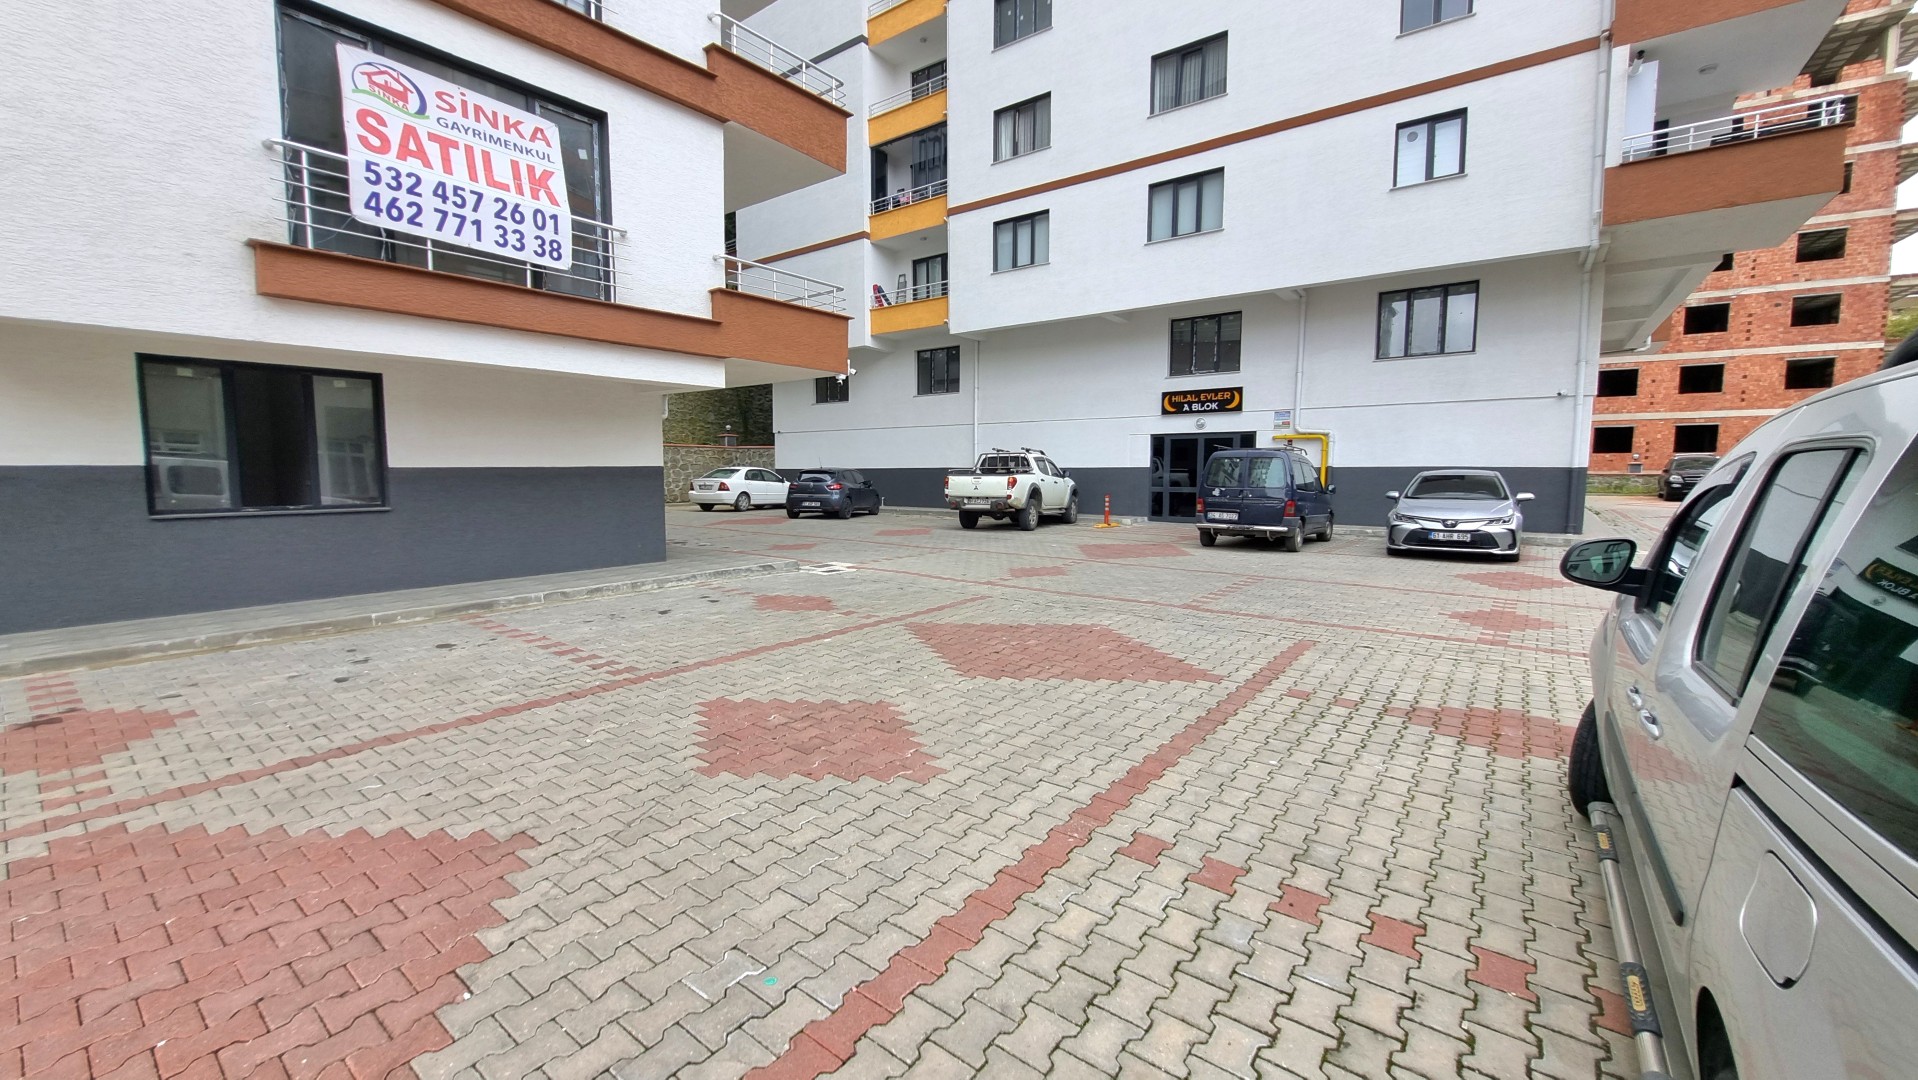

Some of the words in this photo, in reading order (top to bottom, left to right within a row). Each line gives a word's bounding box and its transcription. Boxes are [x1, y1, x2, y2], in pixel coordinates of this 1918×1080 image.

[434, 90, 553, 148] SİNKA
[436, 116, 555, 164] GAYRİMENKUL
[356, 108, 561, 208] SATILIK
[363, 191, 424, 228] 462
[433, 207, 483, 243] 771
[494, 224, 526, 252] 33
[532, 235, 563, 262] 38
[364, 159, 423, 198] 532
[432, 181, 484, 214] 457
[493, 197, 526, 225] 26
[532, 208, 560, 236] 01
[1182, 403, 1190, 412] A
[1192, 402, 1219, 411] BLOK
[1200, 391, 1231, 401] EVLER
